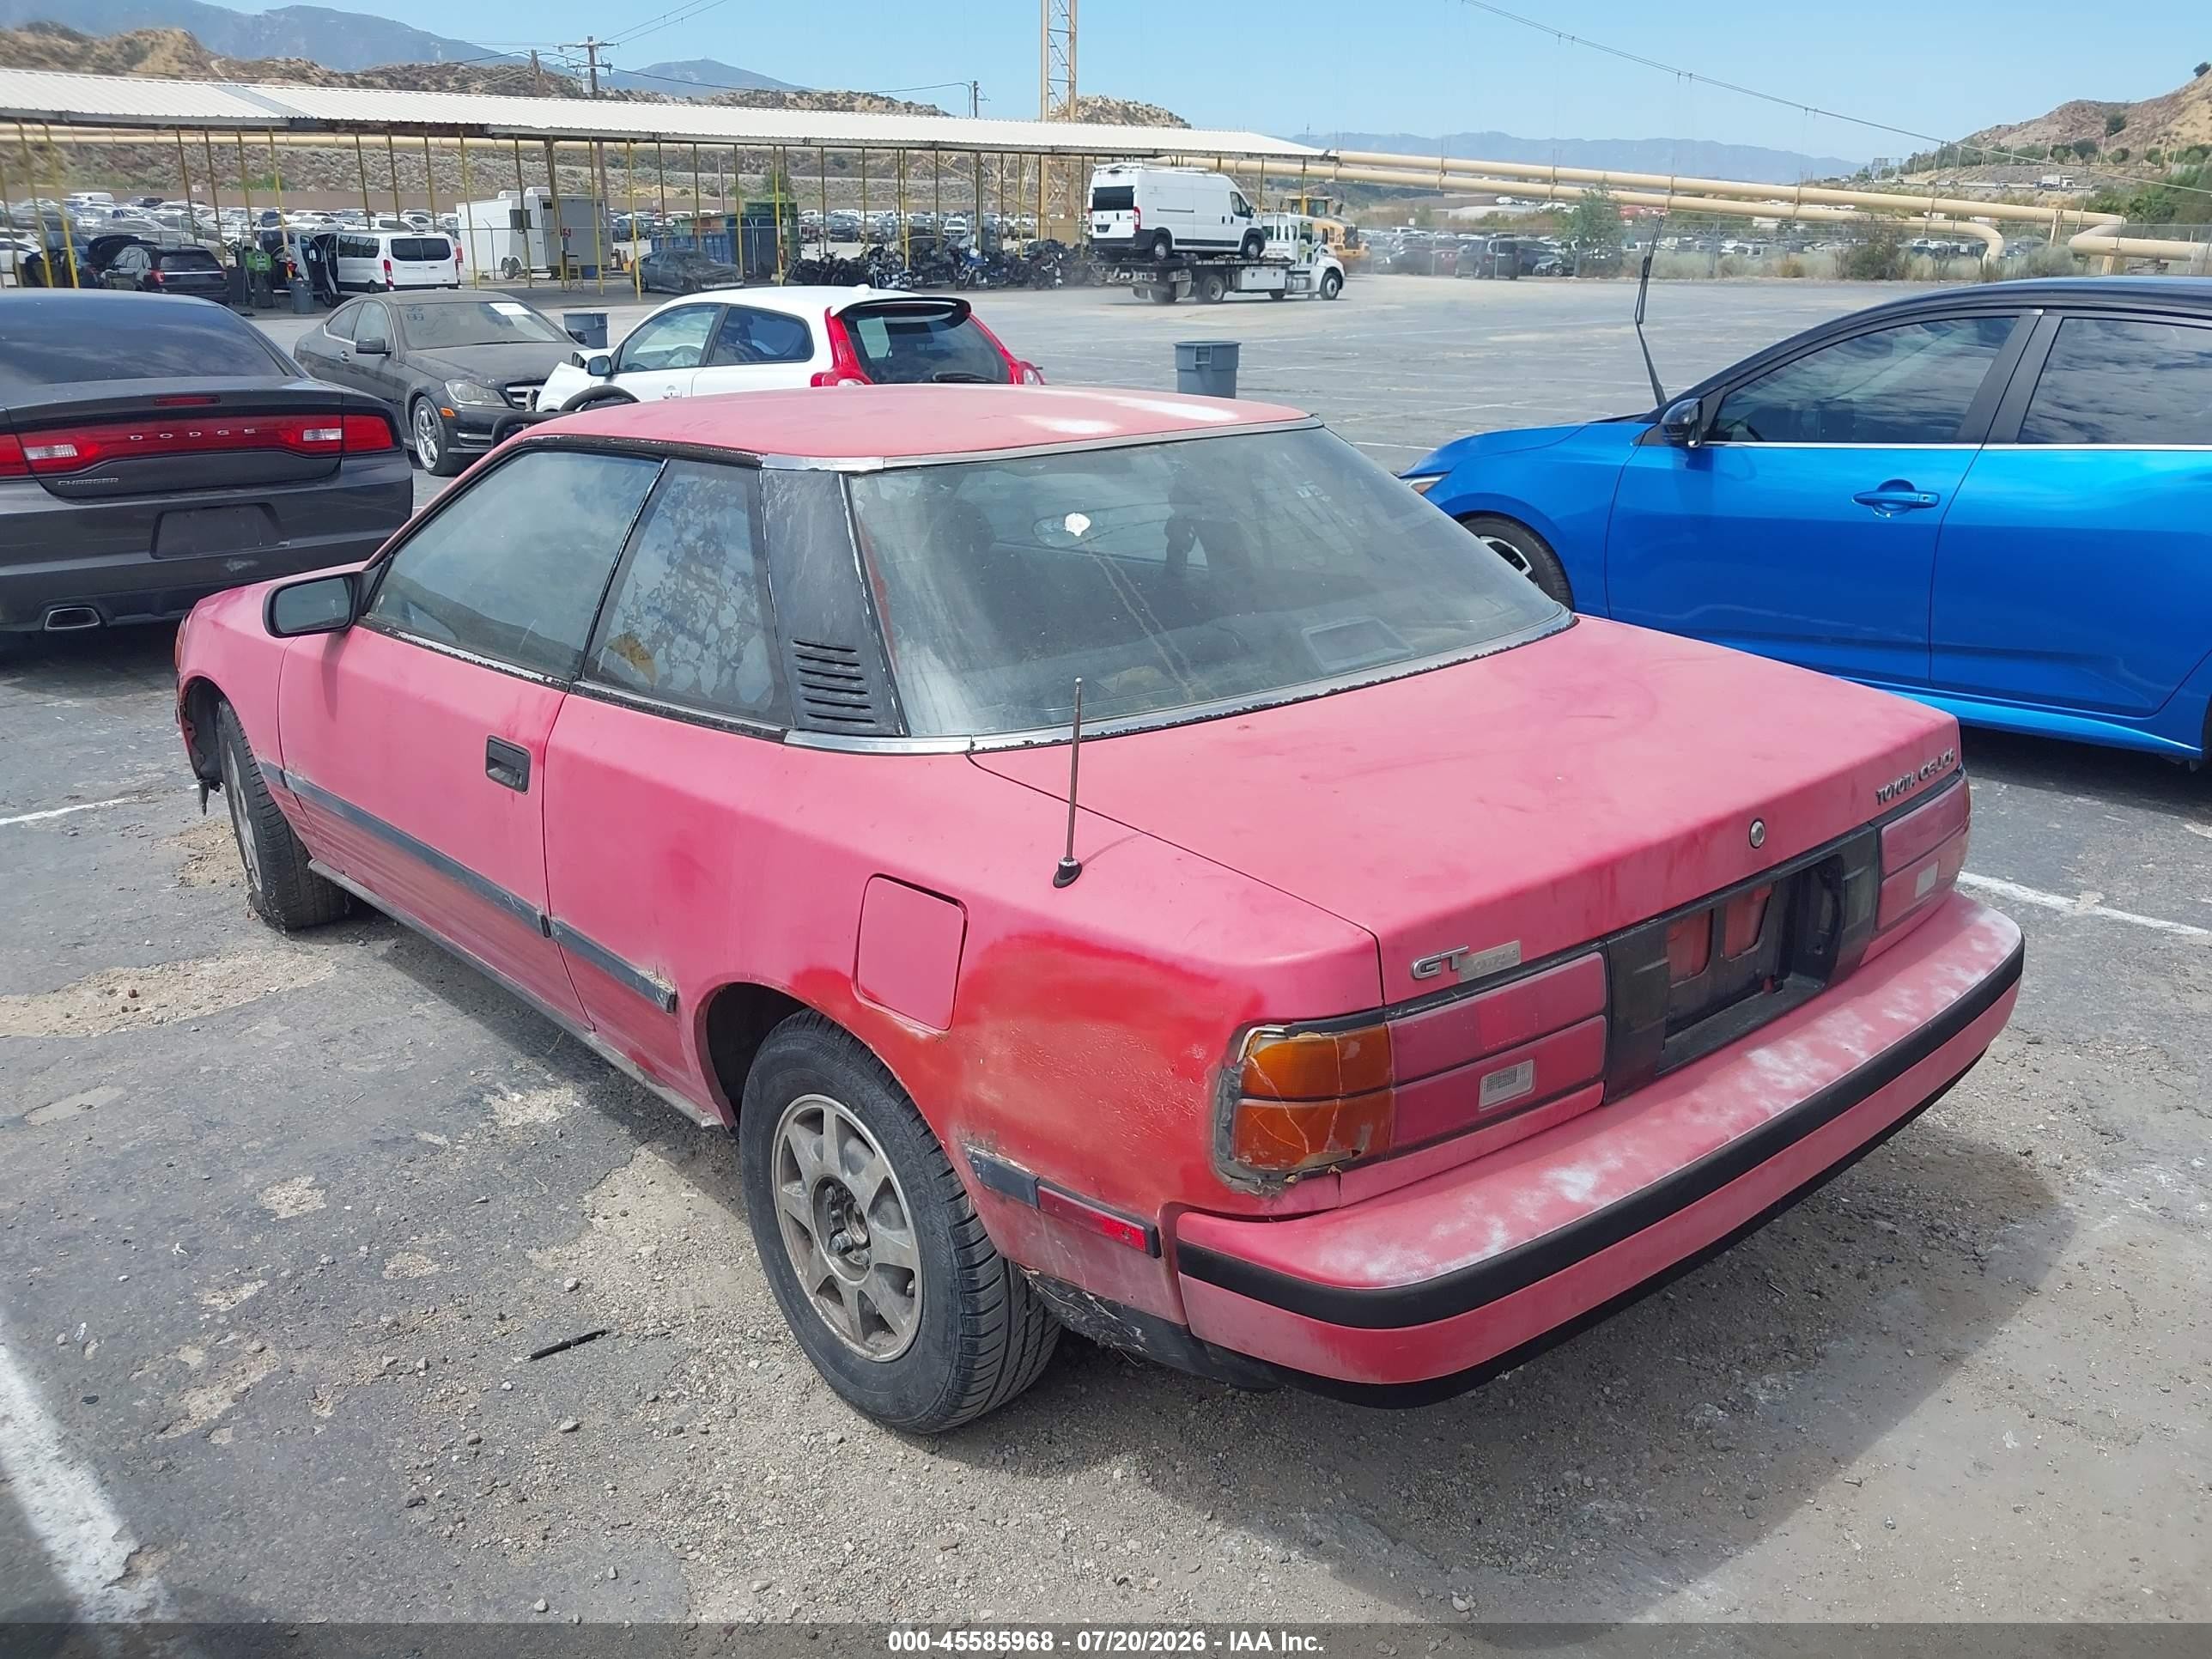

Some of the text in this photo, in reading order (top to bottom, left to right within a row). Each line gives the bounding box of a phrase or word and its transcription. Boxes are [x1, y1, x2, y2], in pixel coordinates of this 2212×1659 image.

[130, 428, 256, 441] DODGE
[58, 477, 118, 486] CHARGER
[1875, 748, 1954, 805] TOYOTA CELICA
[1411, 945, 1469, 979] GT
